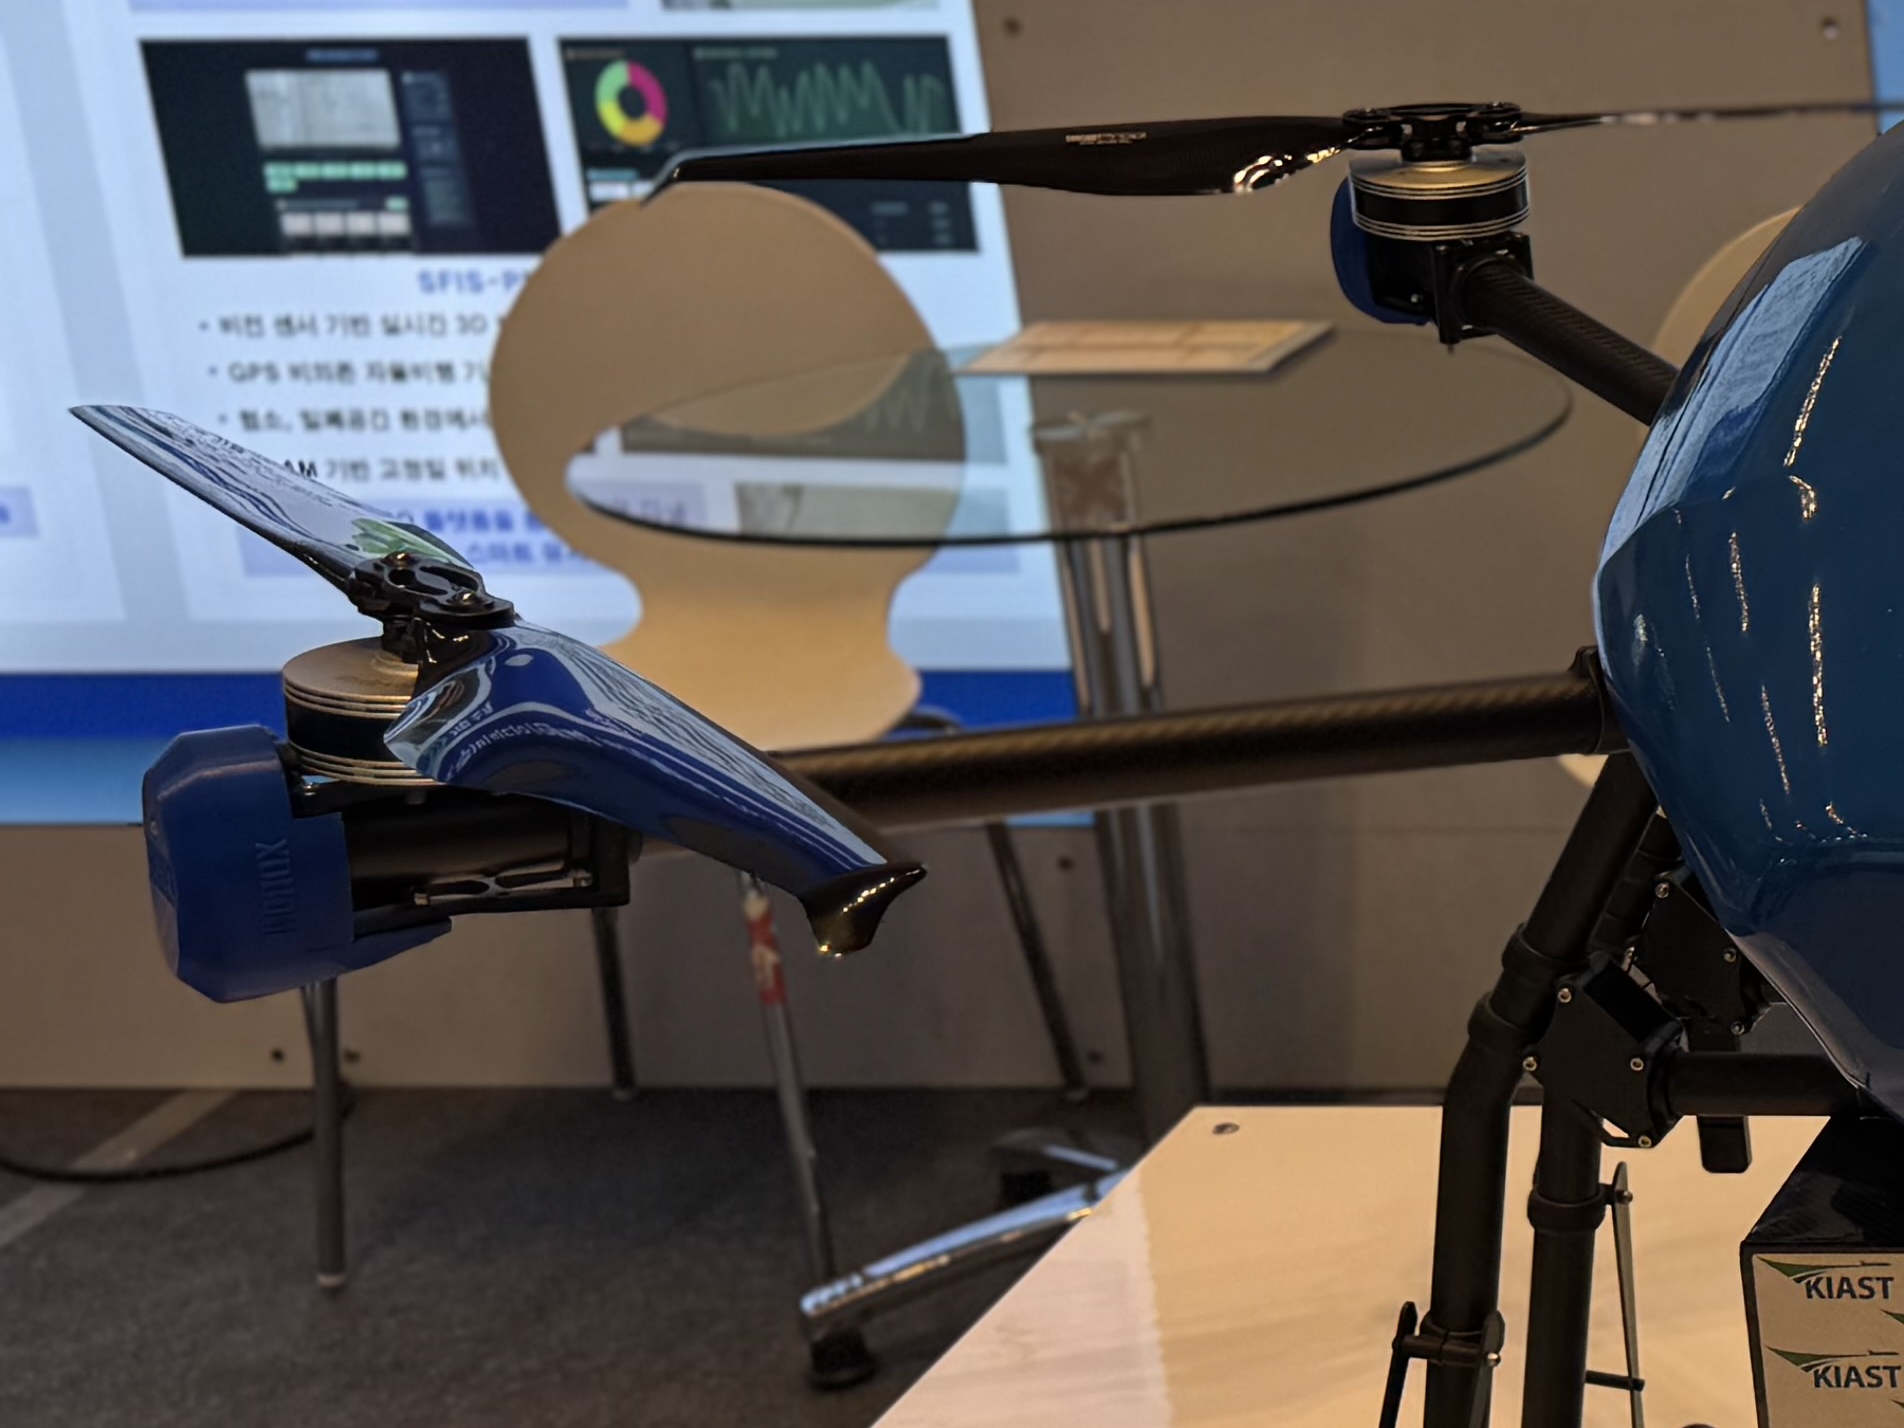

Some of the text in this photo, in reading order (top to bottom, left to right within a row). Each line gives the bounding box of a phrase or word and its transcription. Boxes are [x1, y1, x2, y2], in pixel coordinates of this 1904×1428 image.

[417, 270, 531, 294] SFIS-P
[1801, 1275, 1894, 1299] KIAST
[1809, 1364, 1902, 1388] KIAST
